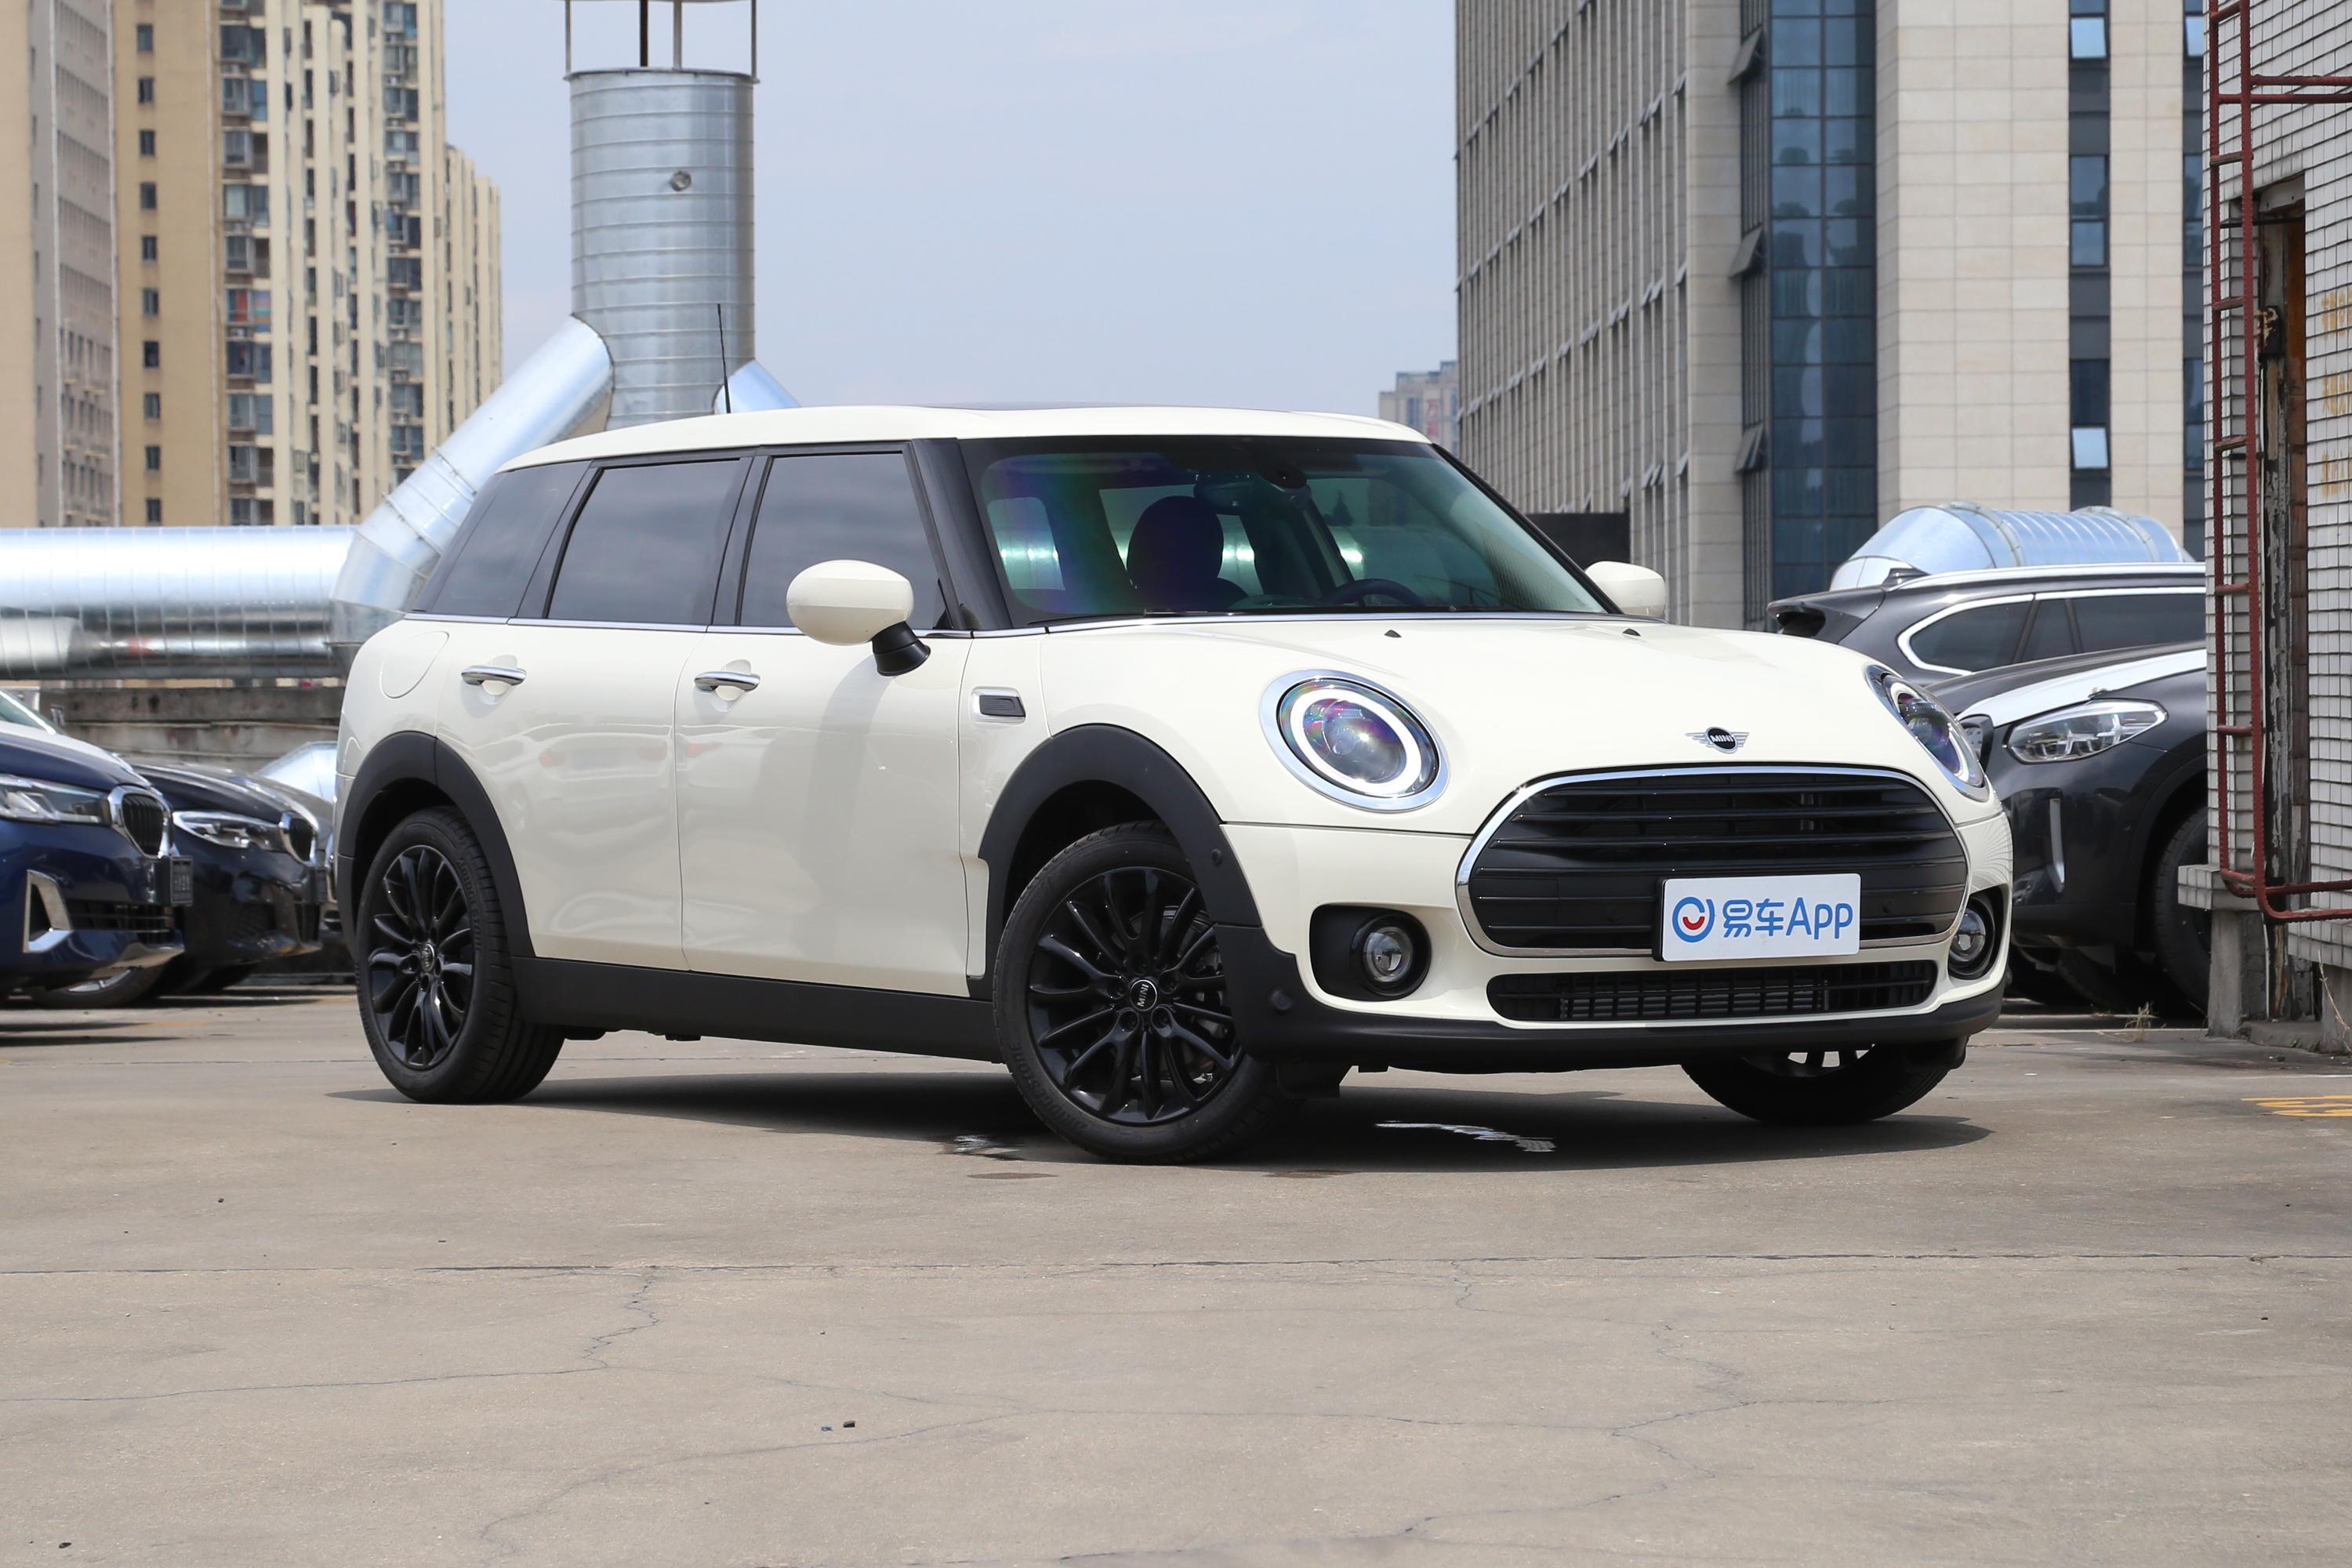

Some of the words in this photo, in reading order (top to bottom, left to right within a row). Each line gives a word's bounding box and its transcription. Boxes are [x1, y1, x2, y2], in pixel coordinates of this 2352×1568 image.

[1710, 735, 1734, 743] MINI
[1722, 897, 1853, 940] 易车App
[1137, 983, 1149, 1007] MINI
